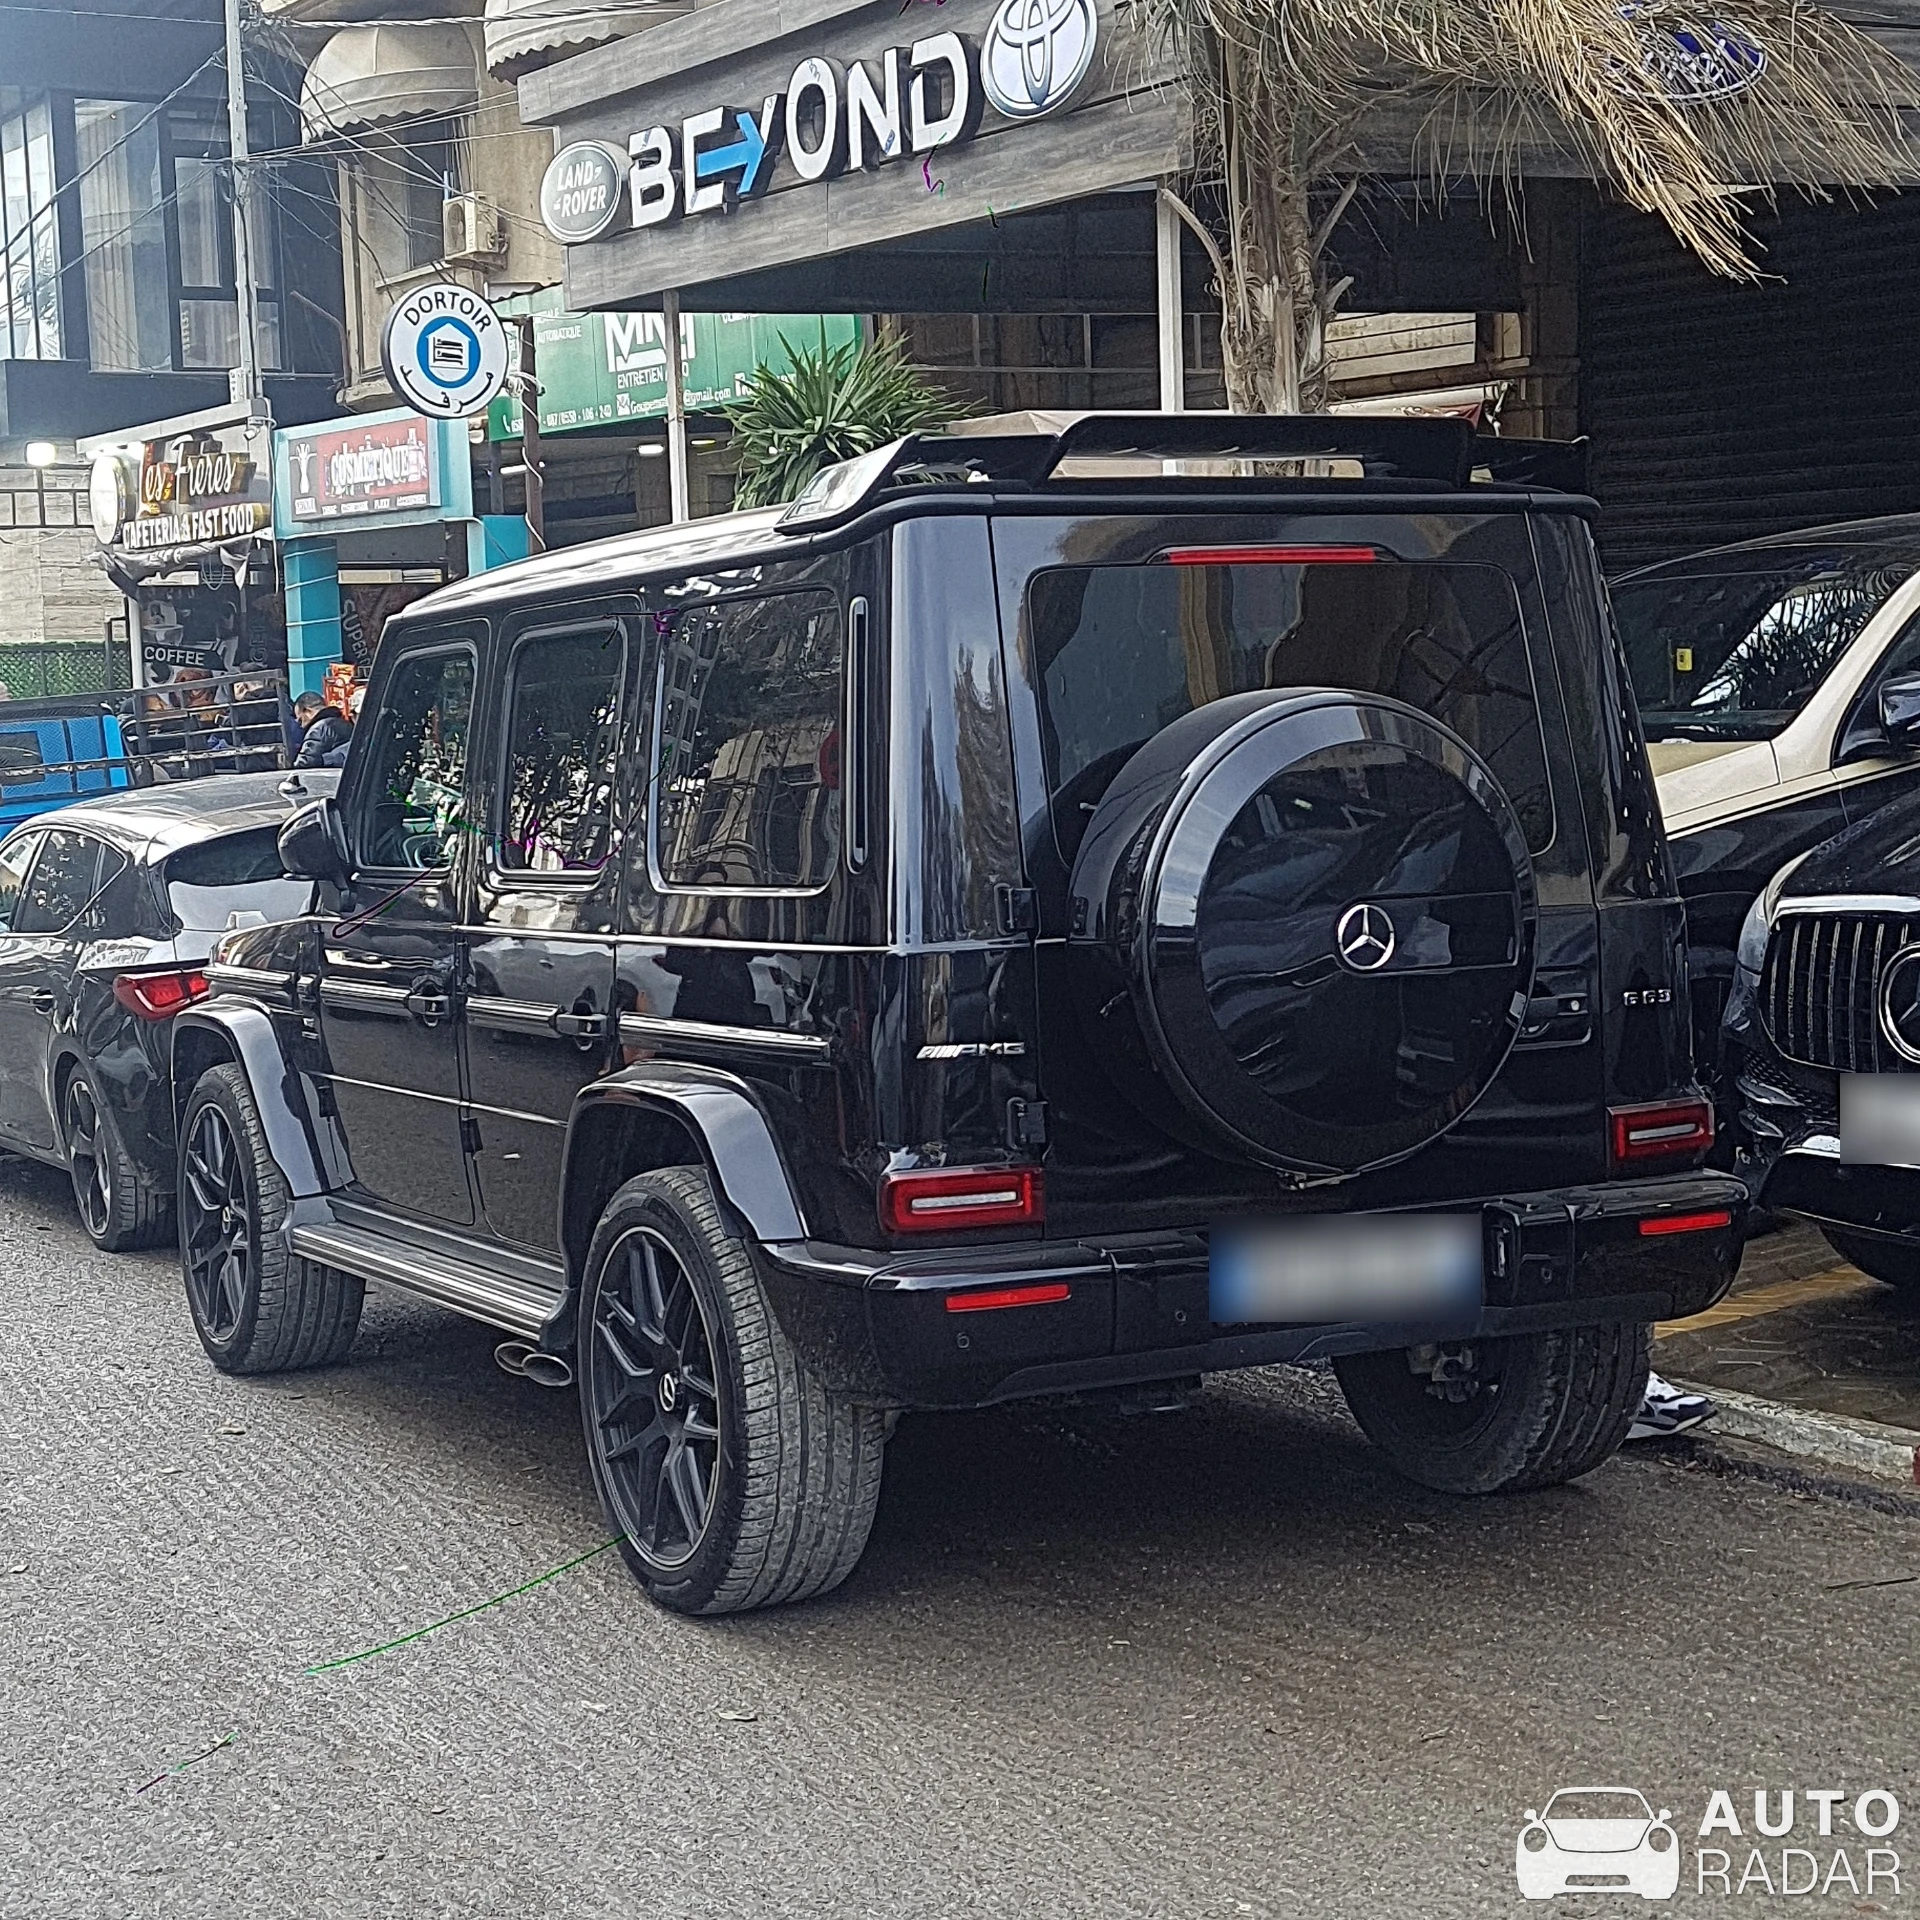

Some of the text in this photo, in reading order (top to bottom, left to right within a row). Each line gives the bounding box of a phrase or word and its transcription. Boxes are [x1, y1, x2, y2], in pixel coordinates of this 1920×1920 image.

[628, 31, 970, 228] BEYOND
[557, 161, 594, 191] LAND
[561, 185, 607, 217] ROVER
[404, 291, 492, 333] DORTOIR
[400, 365, 494, 413] مرقد
[617, 366, 663, 389] ENTRETIEN
[122, 514, 180, 549] CAFETERIA
[192, 509, 220, 540] FAST
[221, 503, 255, 536] FOOD
[144, 646, 205, 667] COFFEE
